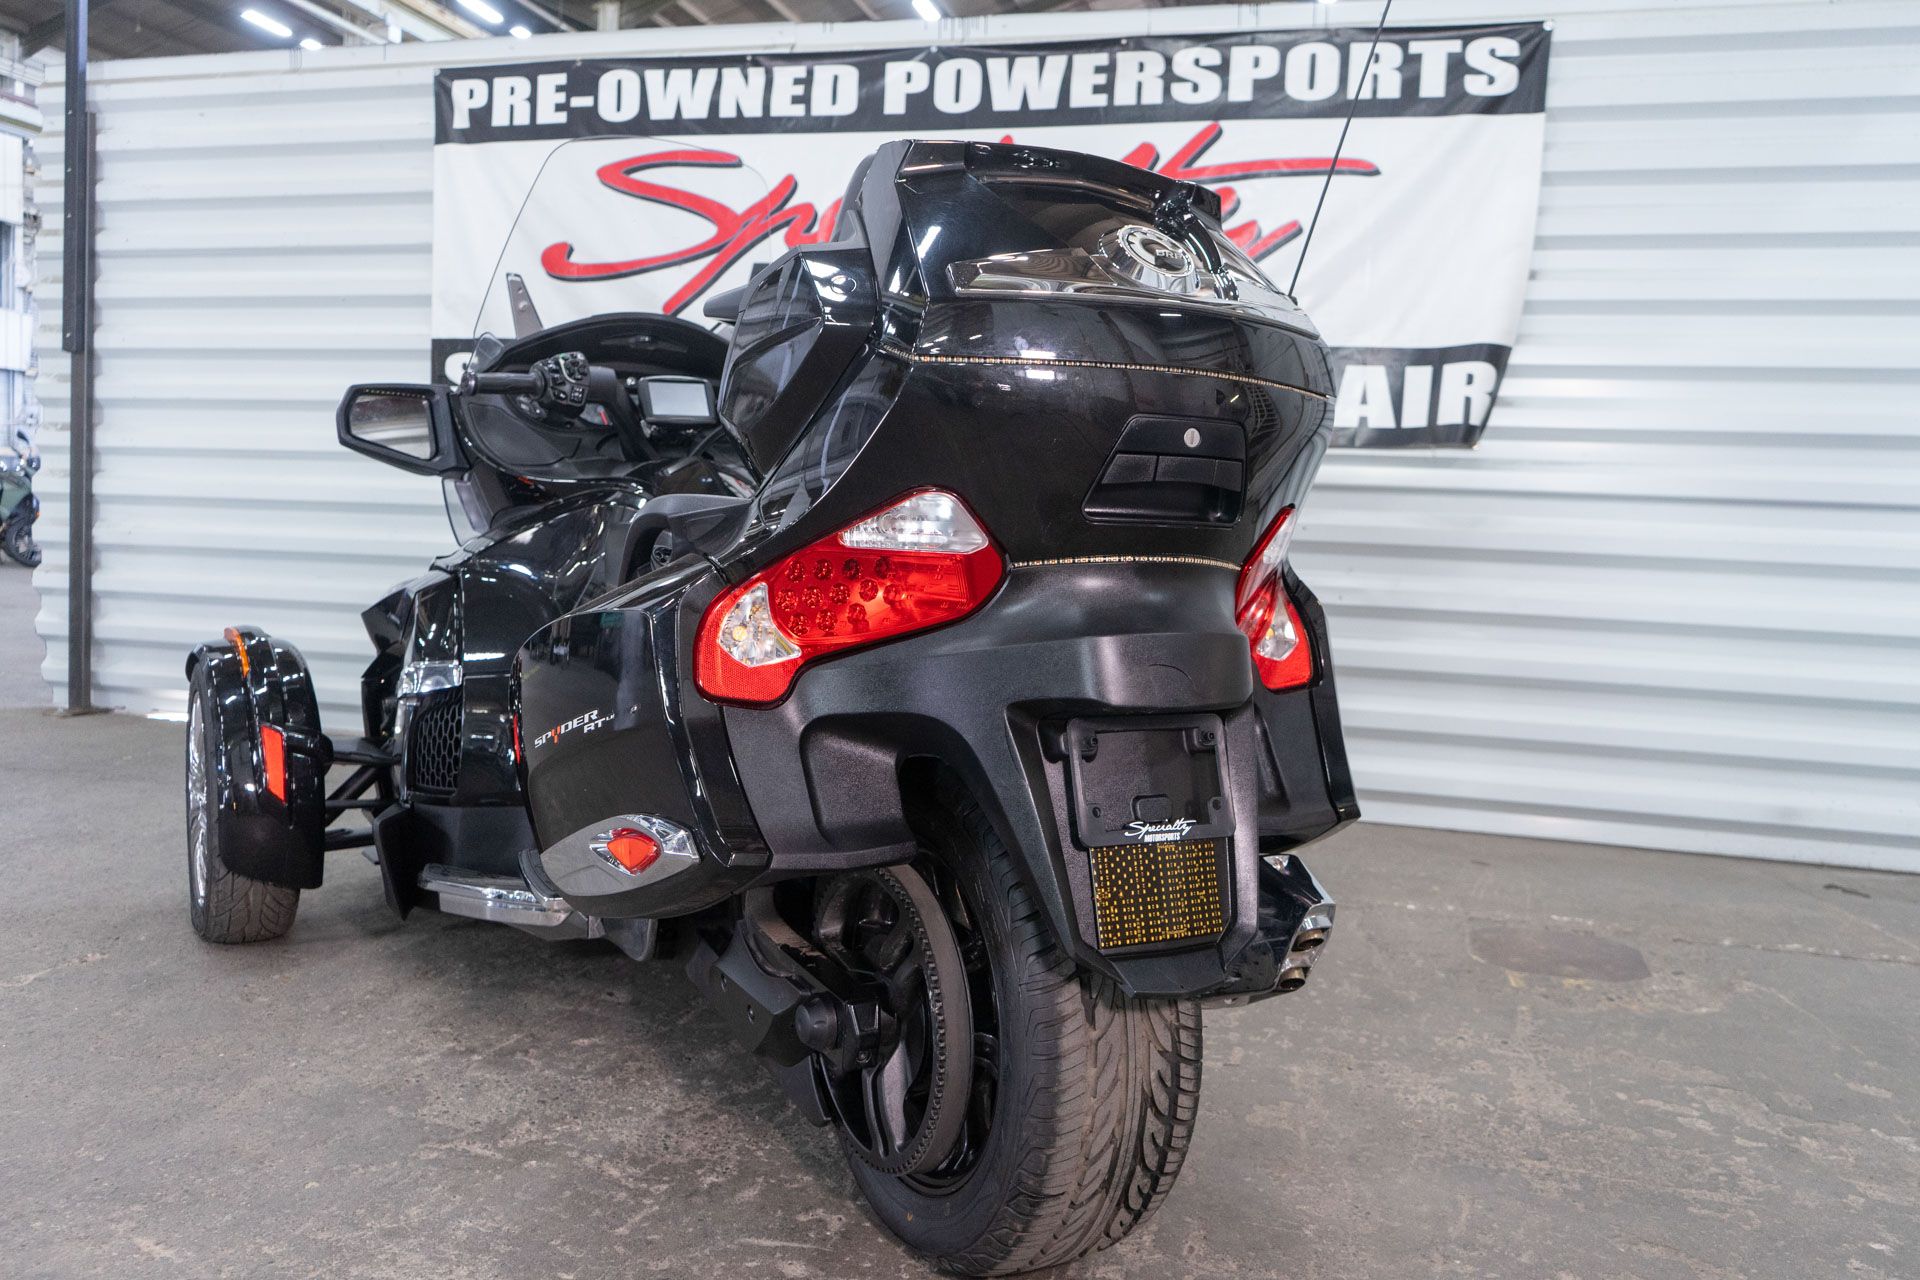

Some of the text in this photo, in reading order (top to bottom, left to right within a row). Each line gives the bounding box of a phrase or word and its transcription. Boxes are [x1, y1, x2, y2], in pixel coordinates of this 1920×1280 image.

[450, 36, 1520, 129] PRE-OWNED POWERSPORTS
[1333, 360, 1498, 429] AIR
[534, 709, 598, 749] SPYDER
[583, 717, 605, 734] RT
[1124, 817, 1197, 840] Specialty
